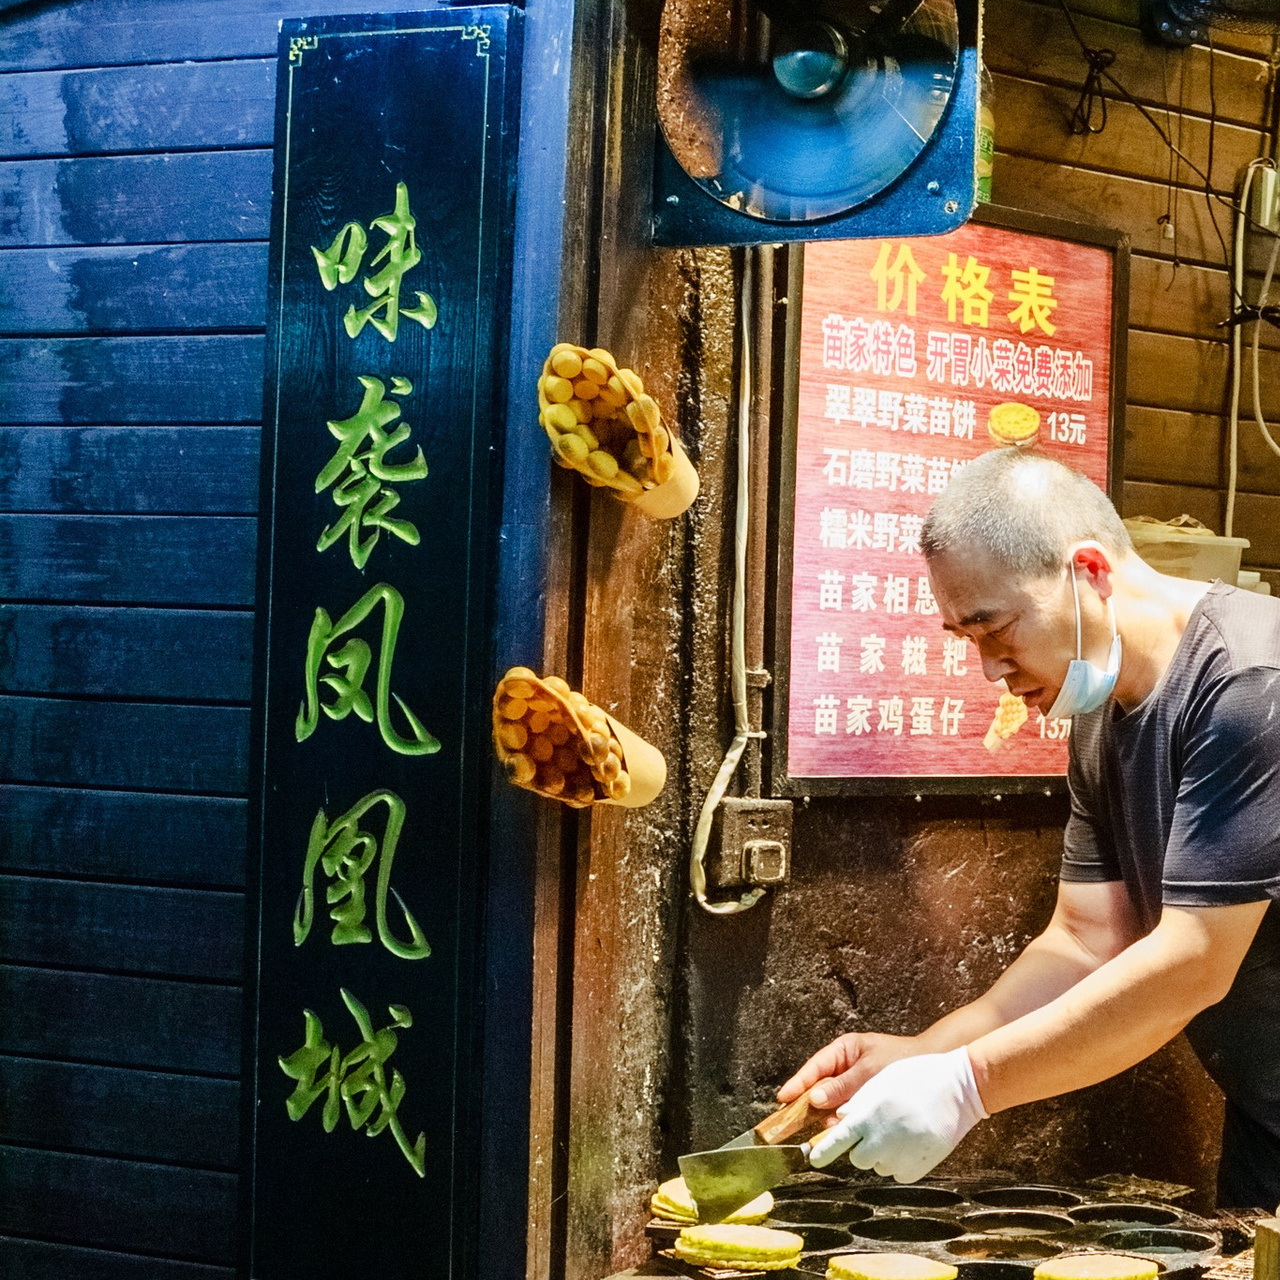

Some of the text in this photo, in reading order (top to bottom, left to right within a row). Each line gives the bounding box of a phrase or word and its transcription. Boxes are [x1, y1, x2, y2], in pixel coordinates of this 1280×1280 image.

[869, 241, 1058, 337] 价格表
[821, 314, 1093, 402] 苗家特色 开胃小菜免费添加
[824, 384, 1087, 445] 翠翠野菜苗饼 13元
[822, 447, 973, 495] 石磨野菜苗
[277, 181, 442, 1178] 味袭凤凰城
[815, 631, 968, 677] 苗家糍粑
[813, 694, 965, 737] 苗家鸡蛋仔
